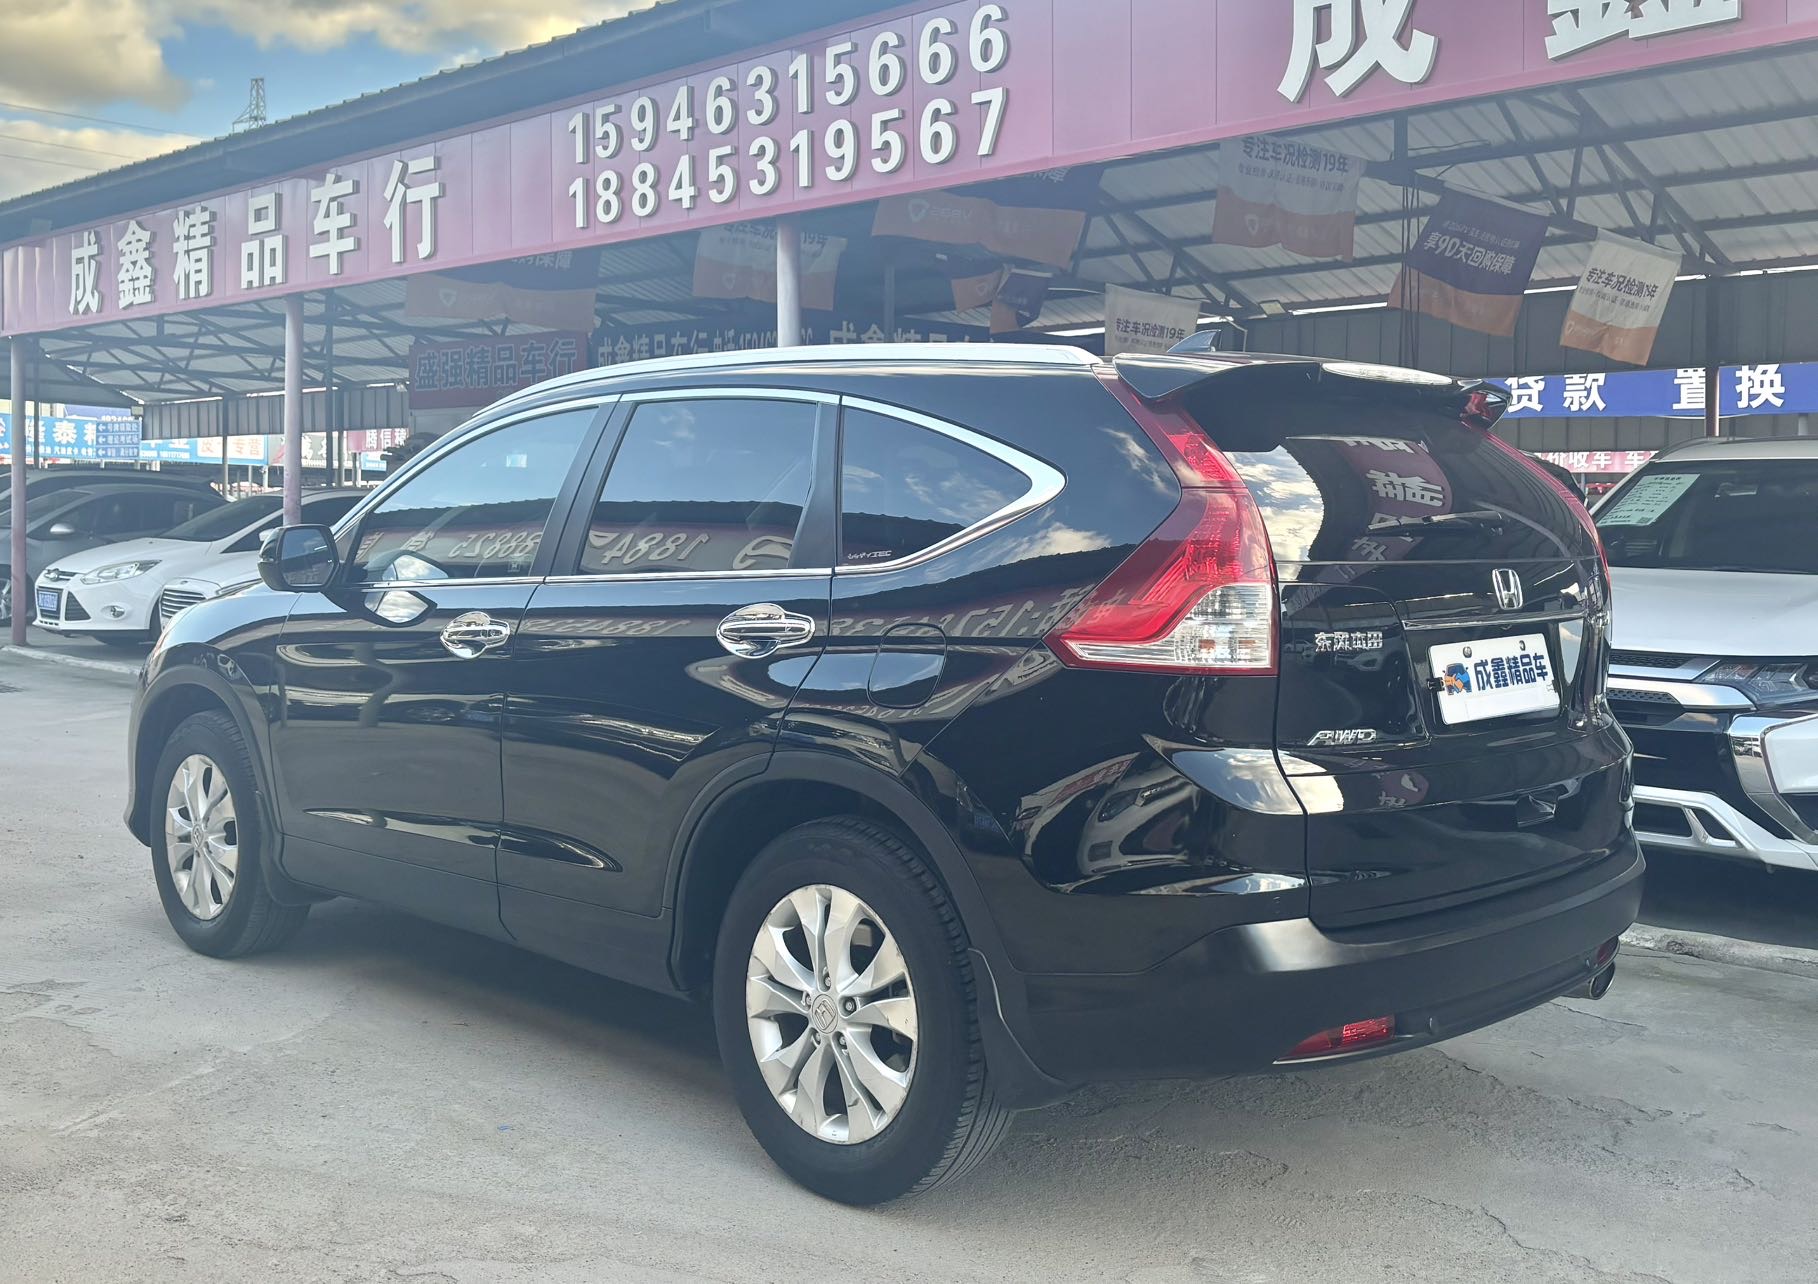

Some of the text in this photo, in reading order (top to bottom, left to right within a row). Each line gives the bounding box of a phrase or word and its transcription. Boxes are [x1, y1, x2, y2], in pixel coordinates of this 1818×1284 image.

[568, 3, 1007, 164] 15946315666
[568, 87, 1006, 229] 18845319567
[1242, 137, 1349, 173] 专注车况检测19年
[69, 156, 443, 315] 成鑫精品车行
[1424, 231, 1517, 275] 享90天回购保障
[415, 337, 577, 392] 盛强精品车行
[1504, 363, 1786, 412] 贷款 置换
[1534, 451, 1612, 468] 价收车
[1314, 631, 1384, 652] 东风本田
[1473, 653, 1549, 691] 成鑫精品车
